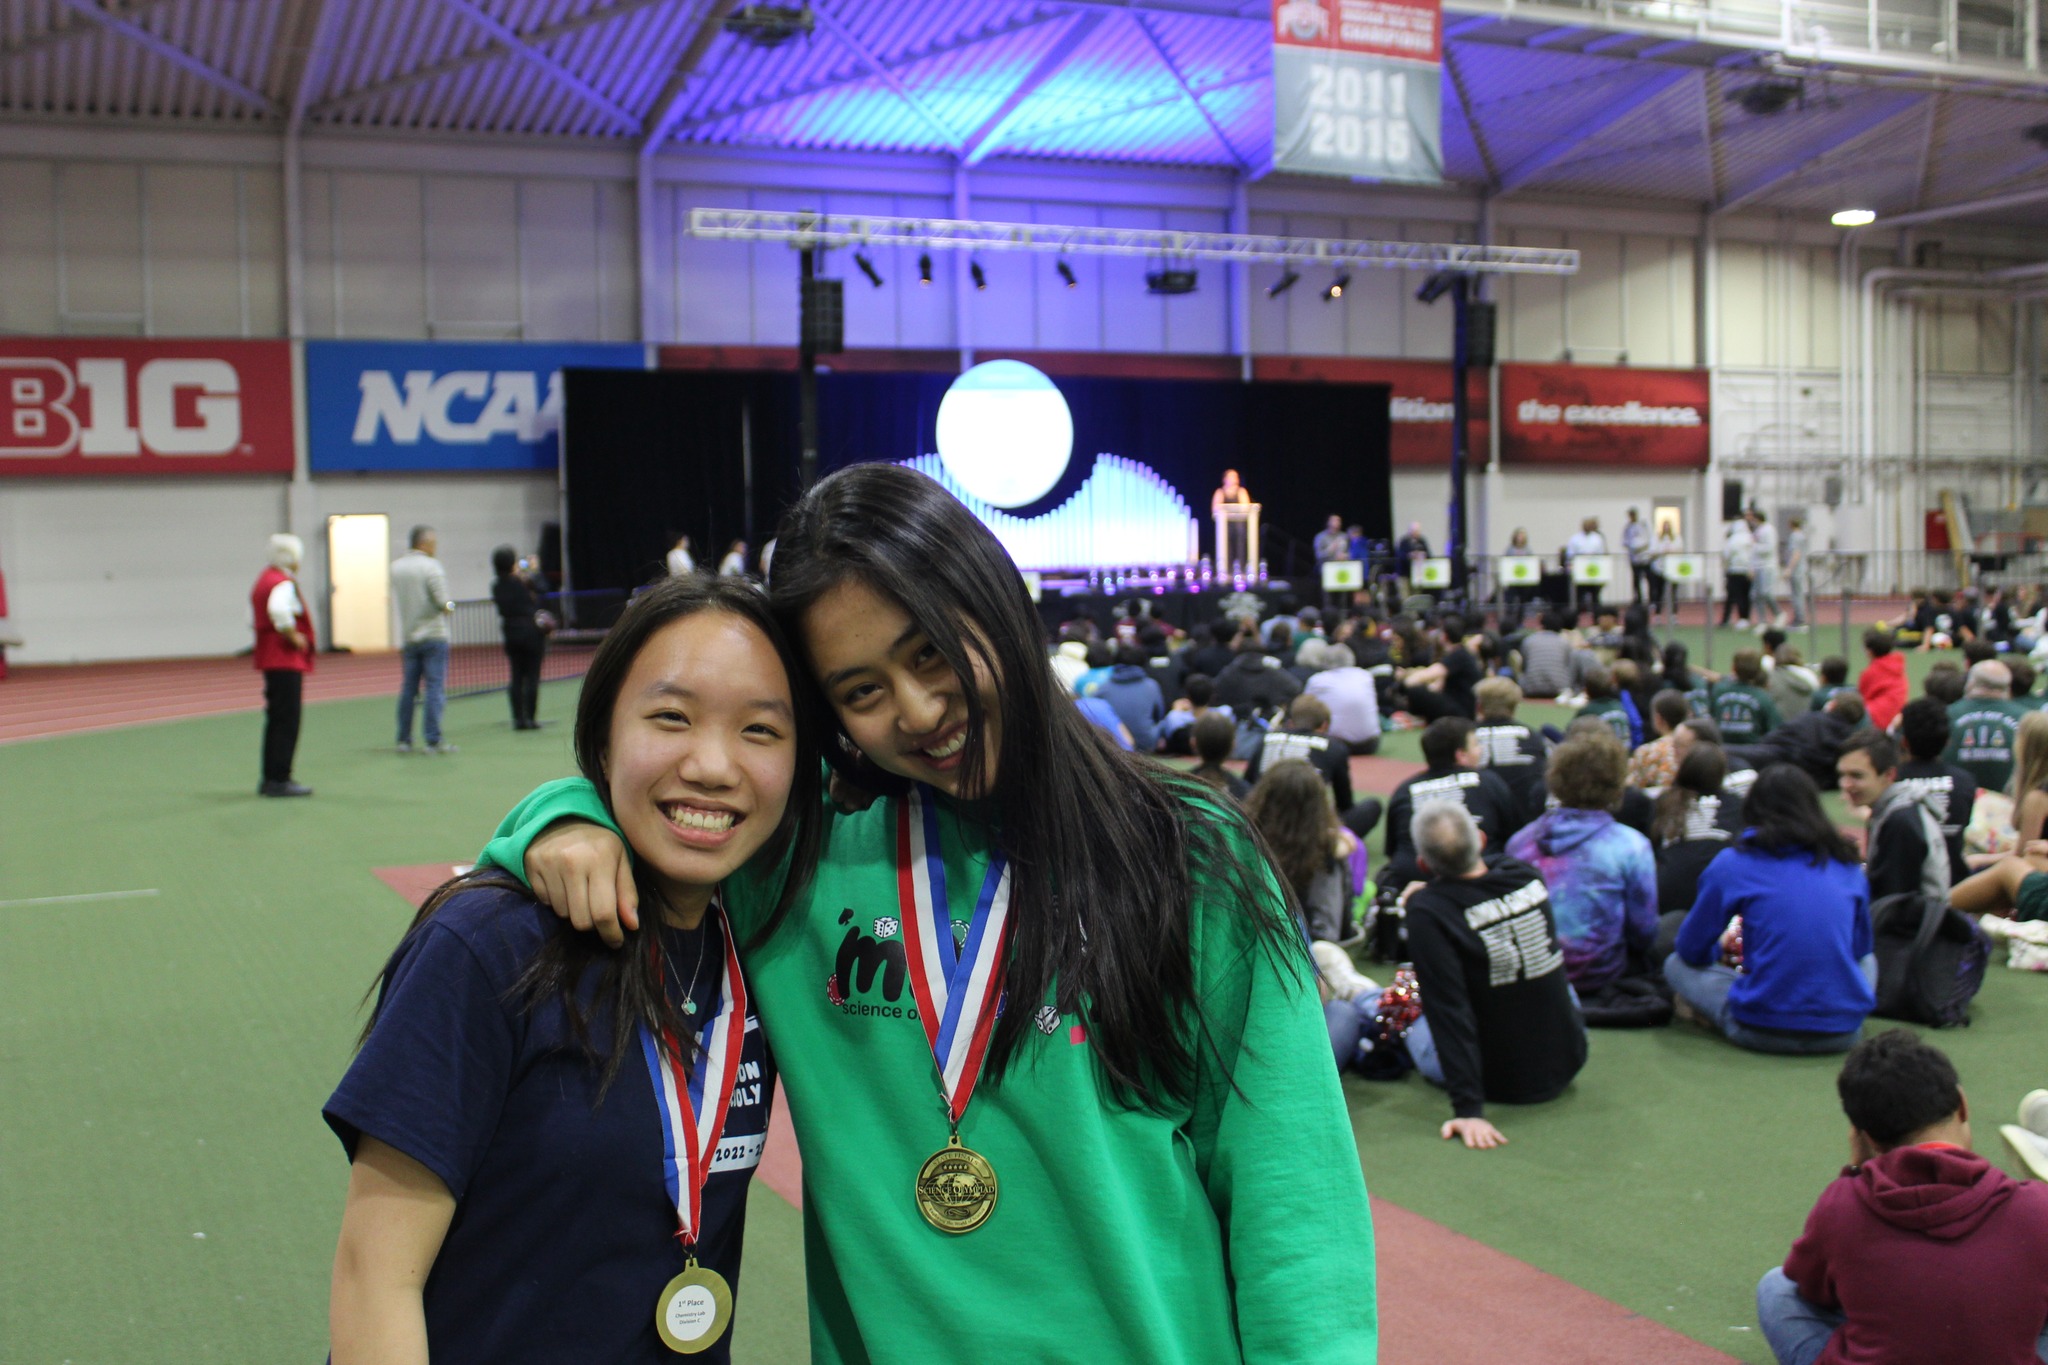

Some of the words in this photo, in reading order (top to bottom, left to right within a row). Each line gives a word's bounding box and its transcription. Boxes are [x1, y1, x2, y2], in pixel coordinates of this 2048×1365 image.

[1310, 64, 1407, 114] 2011
[1517, 399, 1560, 424] the
[842, 1001, 903, 1020] science
[716, 1144, 745, 1163] 2022
